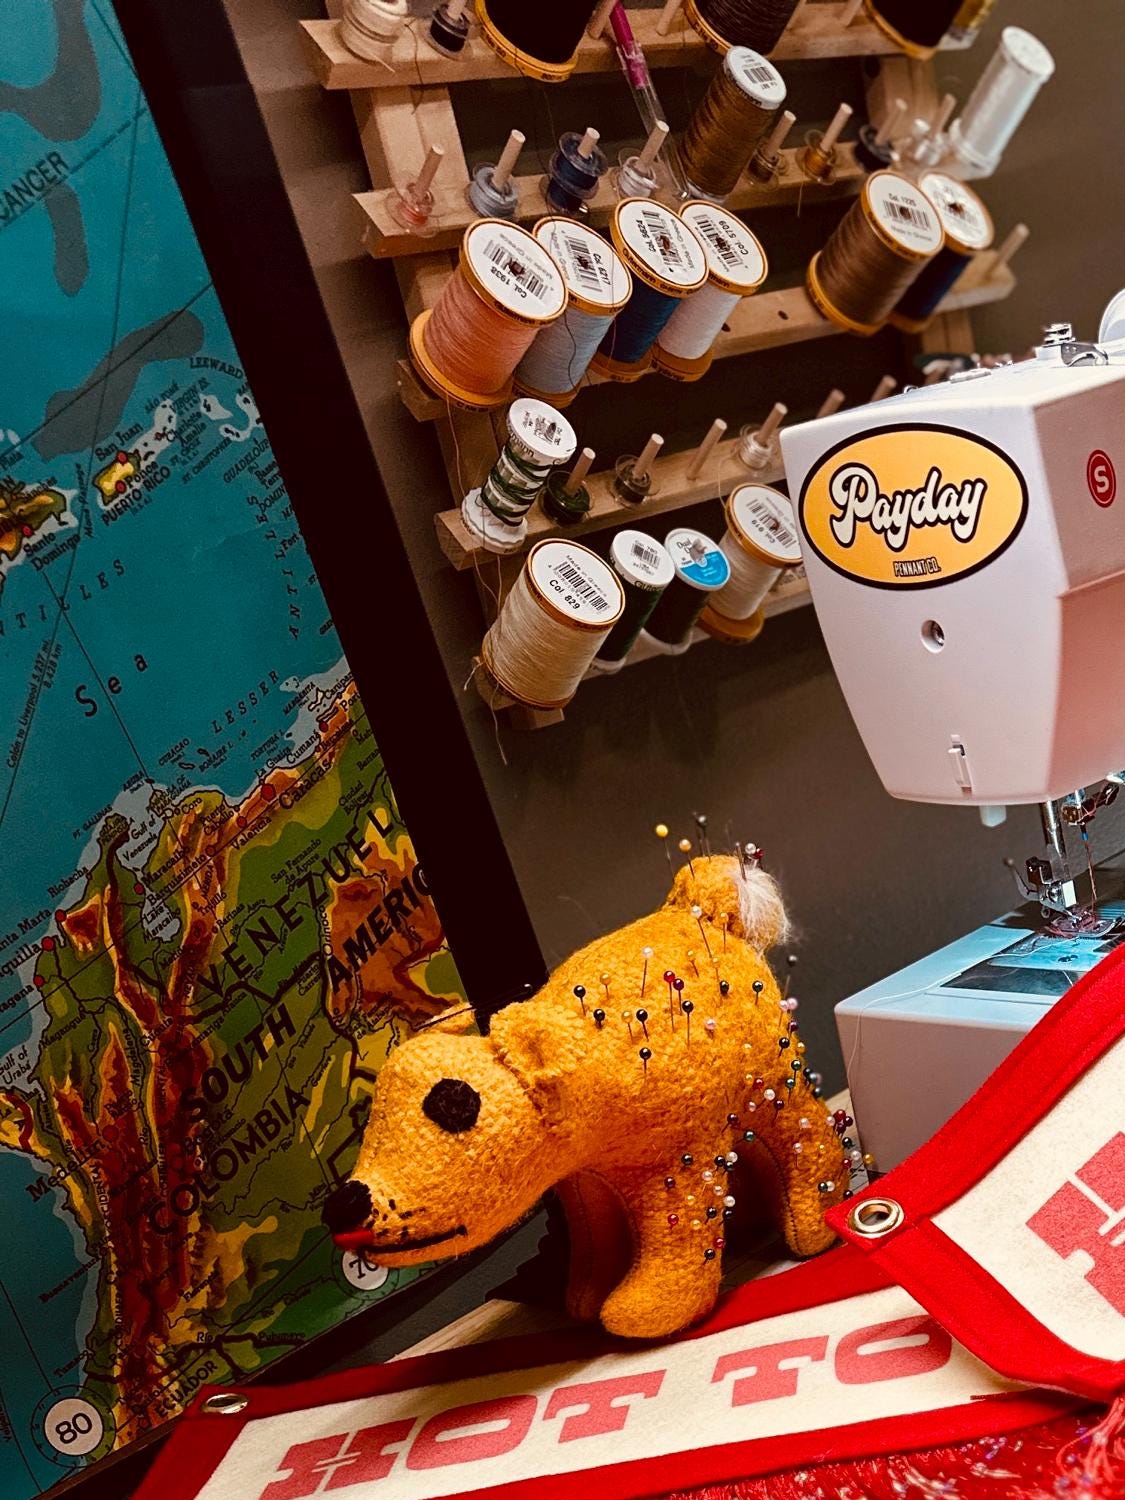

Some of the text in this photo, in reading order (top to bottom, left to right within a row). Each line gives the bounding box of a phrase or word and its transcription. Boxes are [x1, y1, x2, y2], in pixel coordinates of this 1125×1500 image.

[190, 357, 243, 379] LEEWARD
[95, 423, 143, 461] San Juan
[125, 461, 159, 488] Ponce
[101, 488, 142, 525] PUERTO
[143, 466, 171, 494] RICO
[830, 462, 987, 552] Payday
[24, 531, 56, 557] Santo
[31, 534, 80, 571] Domingo
[893, 558, 926, 577] PENNANT
[564, 594, 581, 610] 829
[75, 652, 149, 717] Sea
[212, 669, 280, 734] LESSER
[279, 757, 332, 810] Caracas
[180, 797, 203, 815] Coro
[122, 831, 159, 862] Venezuela
[131, 820, 149, 841] Gulf
[231, 815, 273, 851] Valencia
[141, 845, 191, 886] Maracaibo
[147, 854, 208, 906] Barquisimeto
[270, 838, 321, 885] San Fernando
[47, 866, 89, 898] Riohacha
[17, 907, 52, 935] Marta
[143, 904, 165, 925] Lake
[143, 908, 181, 944] Maracaibo
[215, 902, 245, 930] Barinas
[320, 904, 334, 957] Orinoco
[0, 941, 41, 978] quilla
[183, 1003, 297, 1124] SOUTH
[149, 1085, 311, 1236] COLOMBIA
[709, 1313, 954, 1408] TO
[153, 1359, 218, 1419] ECUADOR
[55, 1412, 93, 1444] 80
